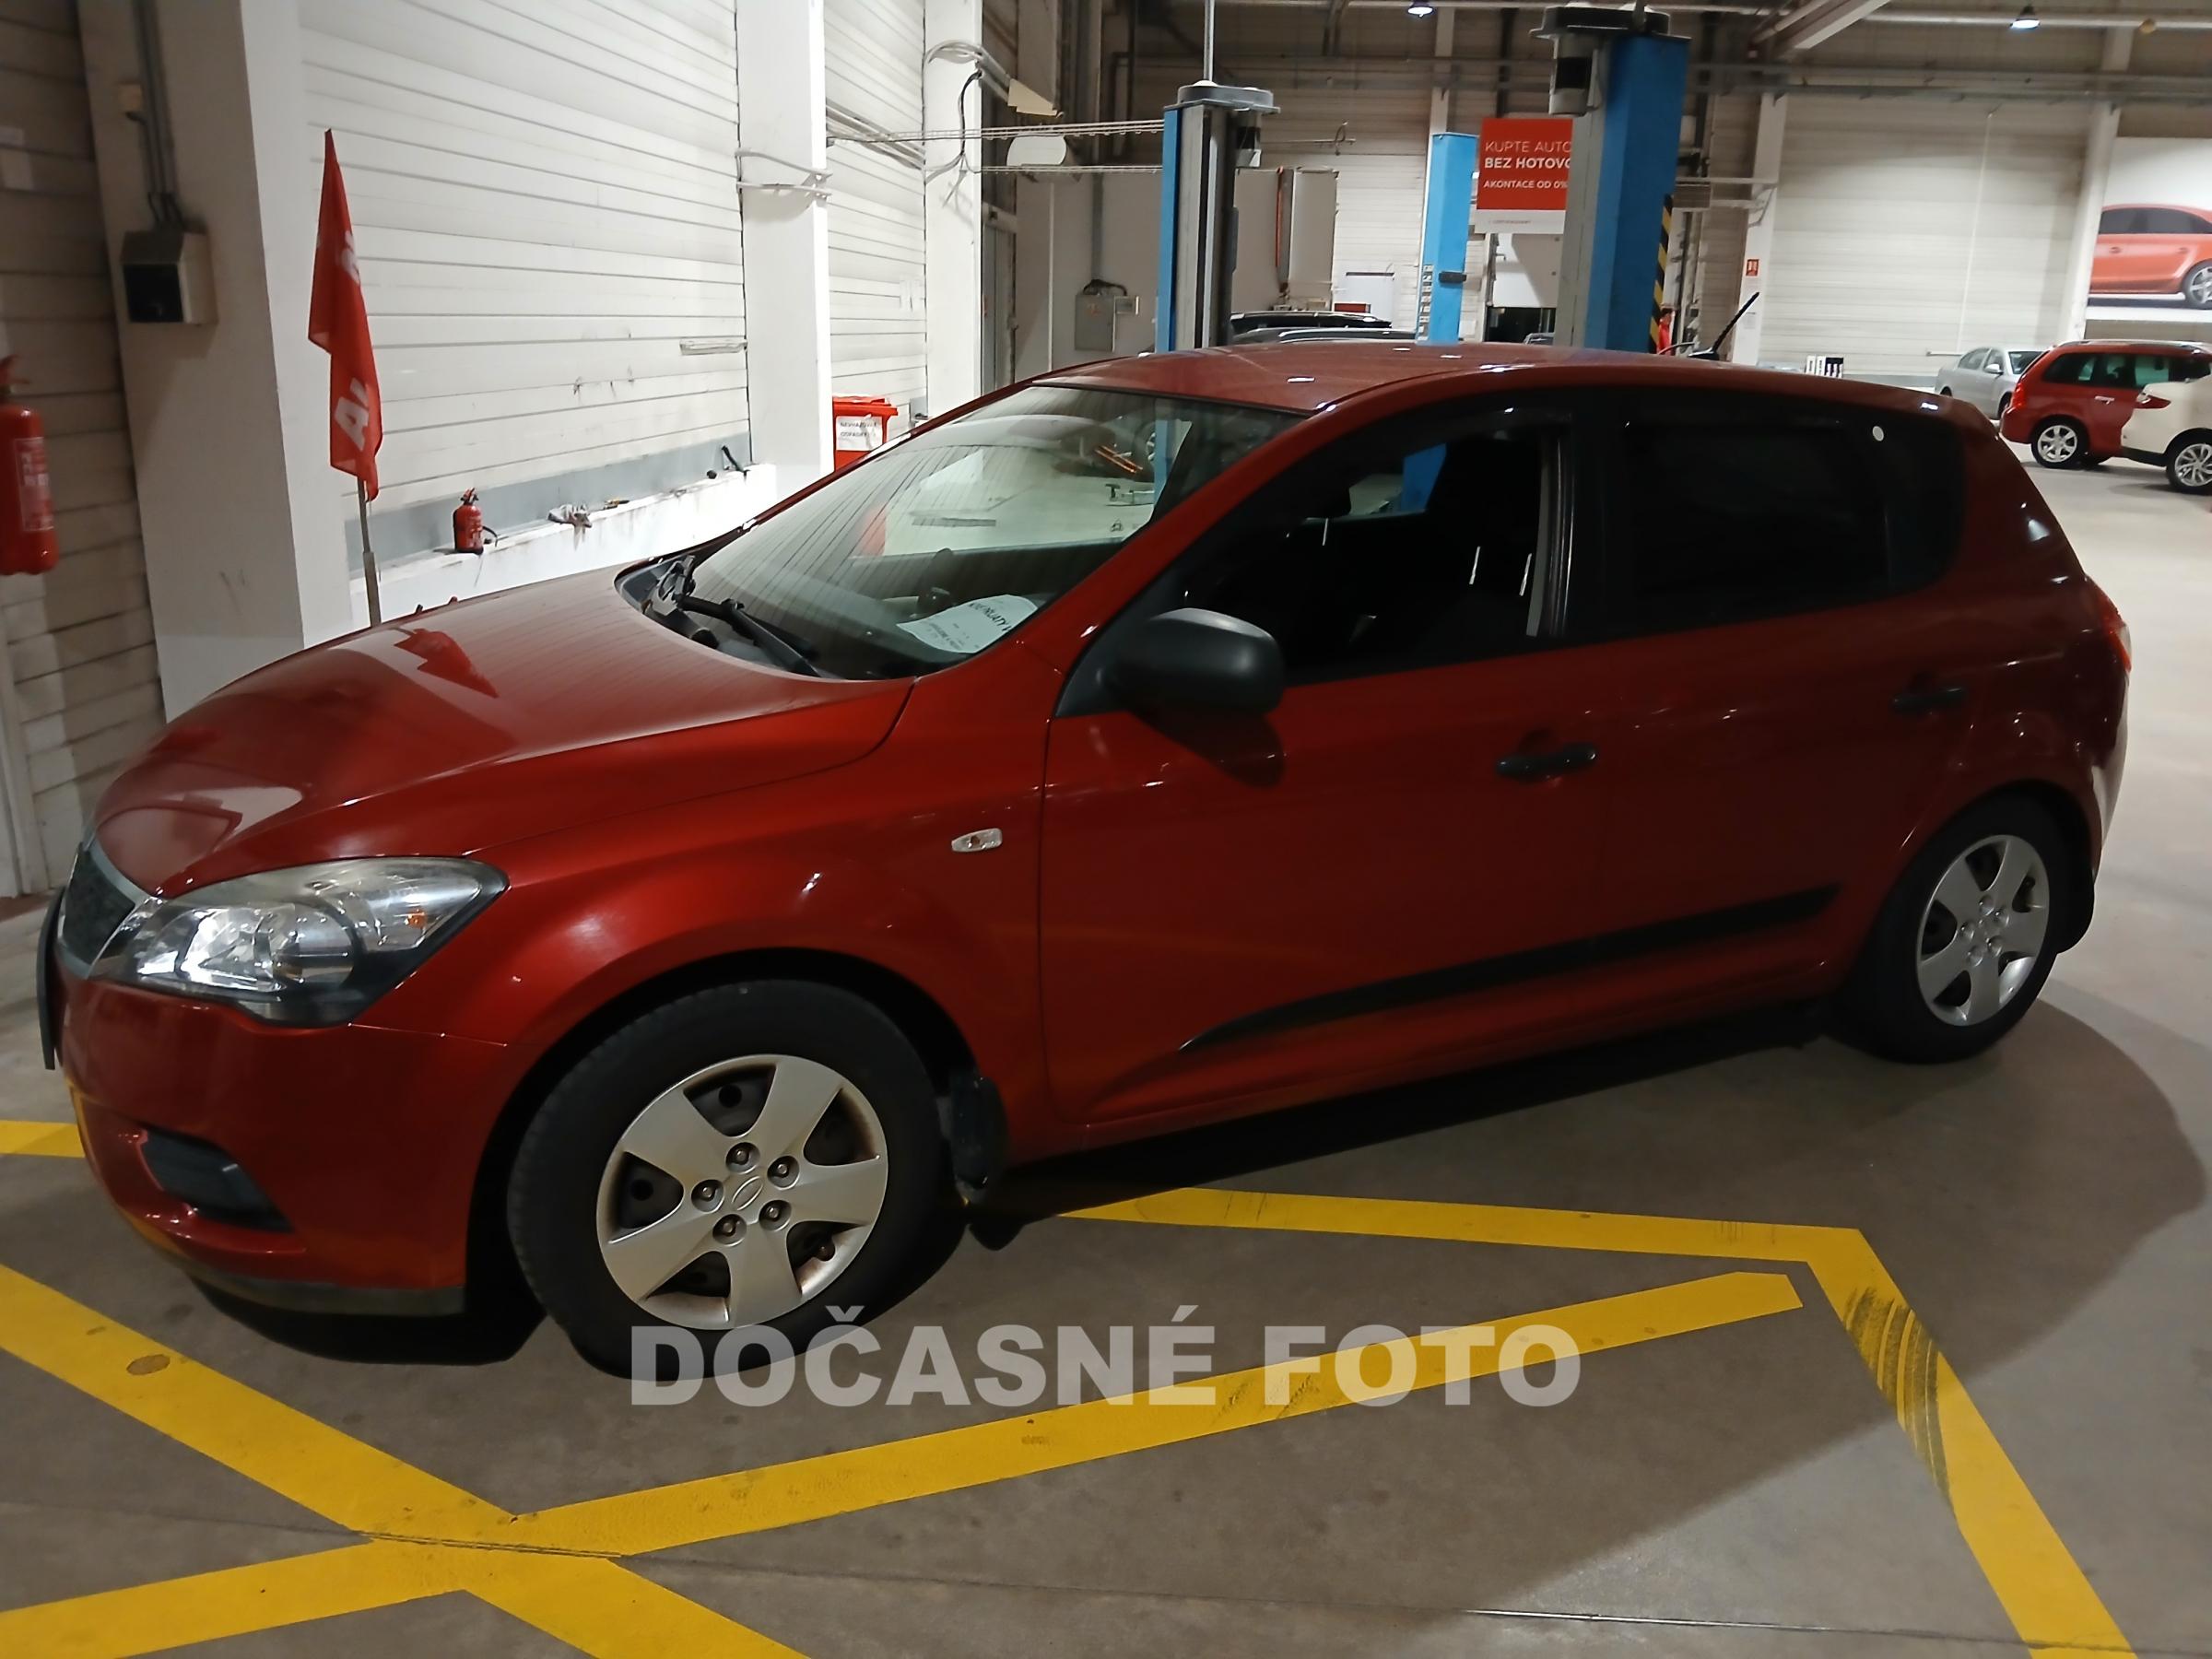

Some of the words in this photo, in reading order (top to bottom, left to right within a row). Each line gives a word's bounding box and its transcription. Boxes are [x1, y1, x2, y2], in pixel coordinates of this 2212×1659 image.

[1485, 141, 1530, 153] KUPTE
[1484, 157, 1512, 169] BEZ
[1483, 180, 1535, 189] AKONTACE
[1536, 180, 1552, 189] OD
